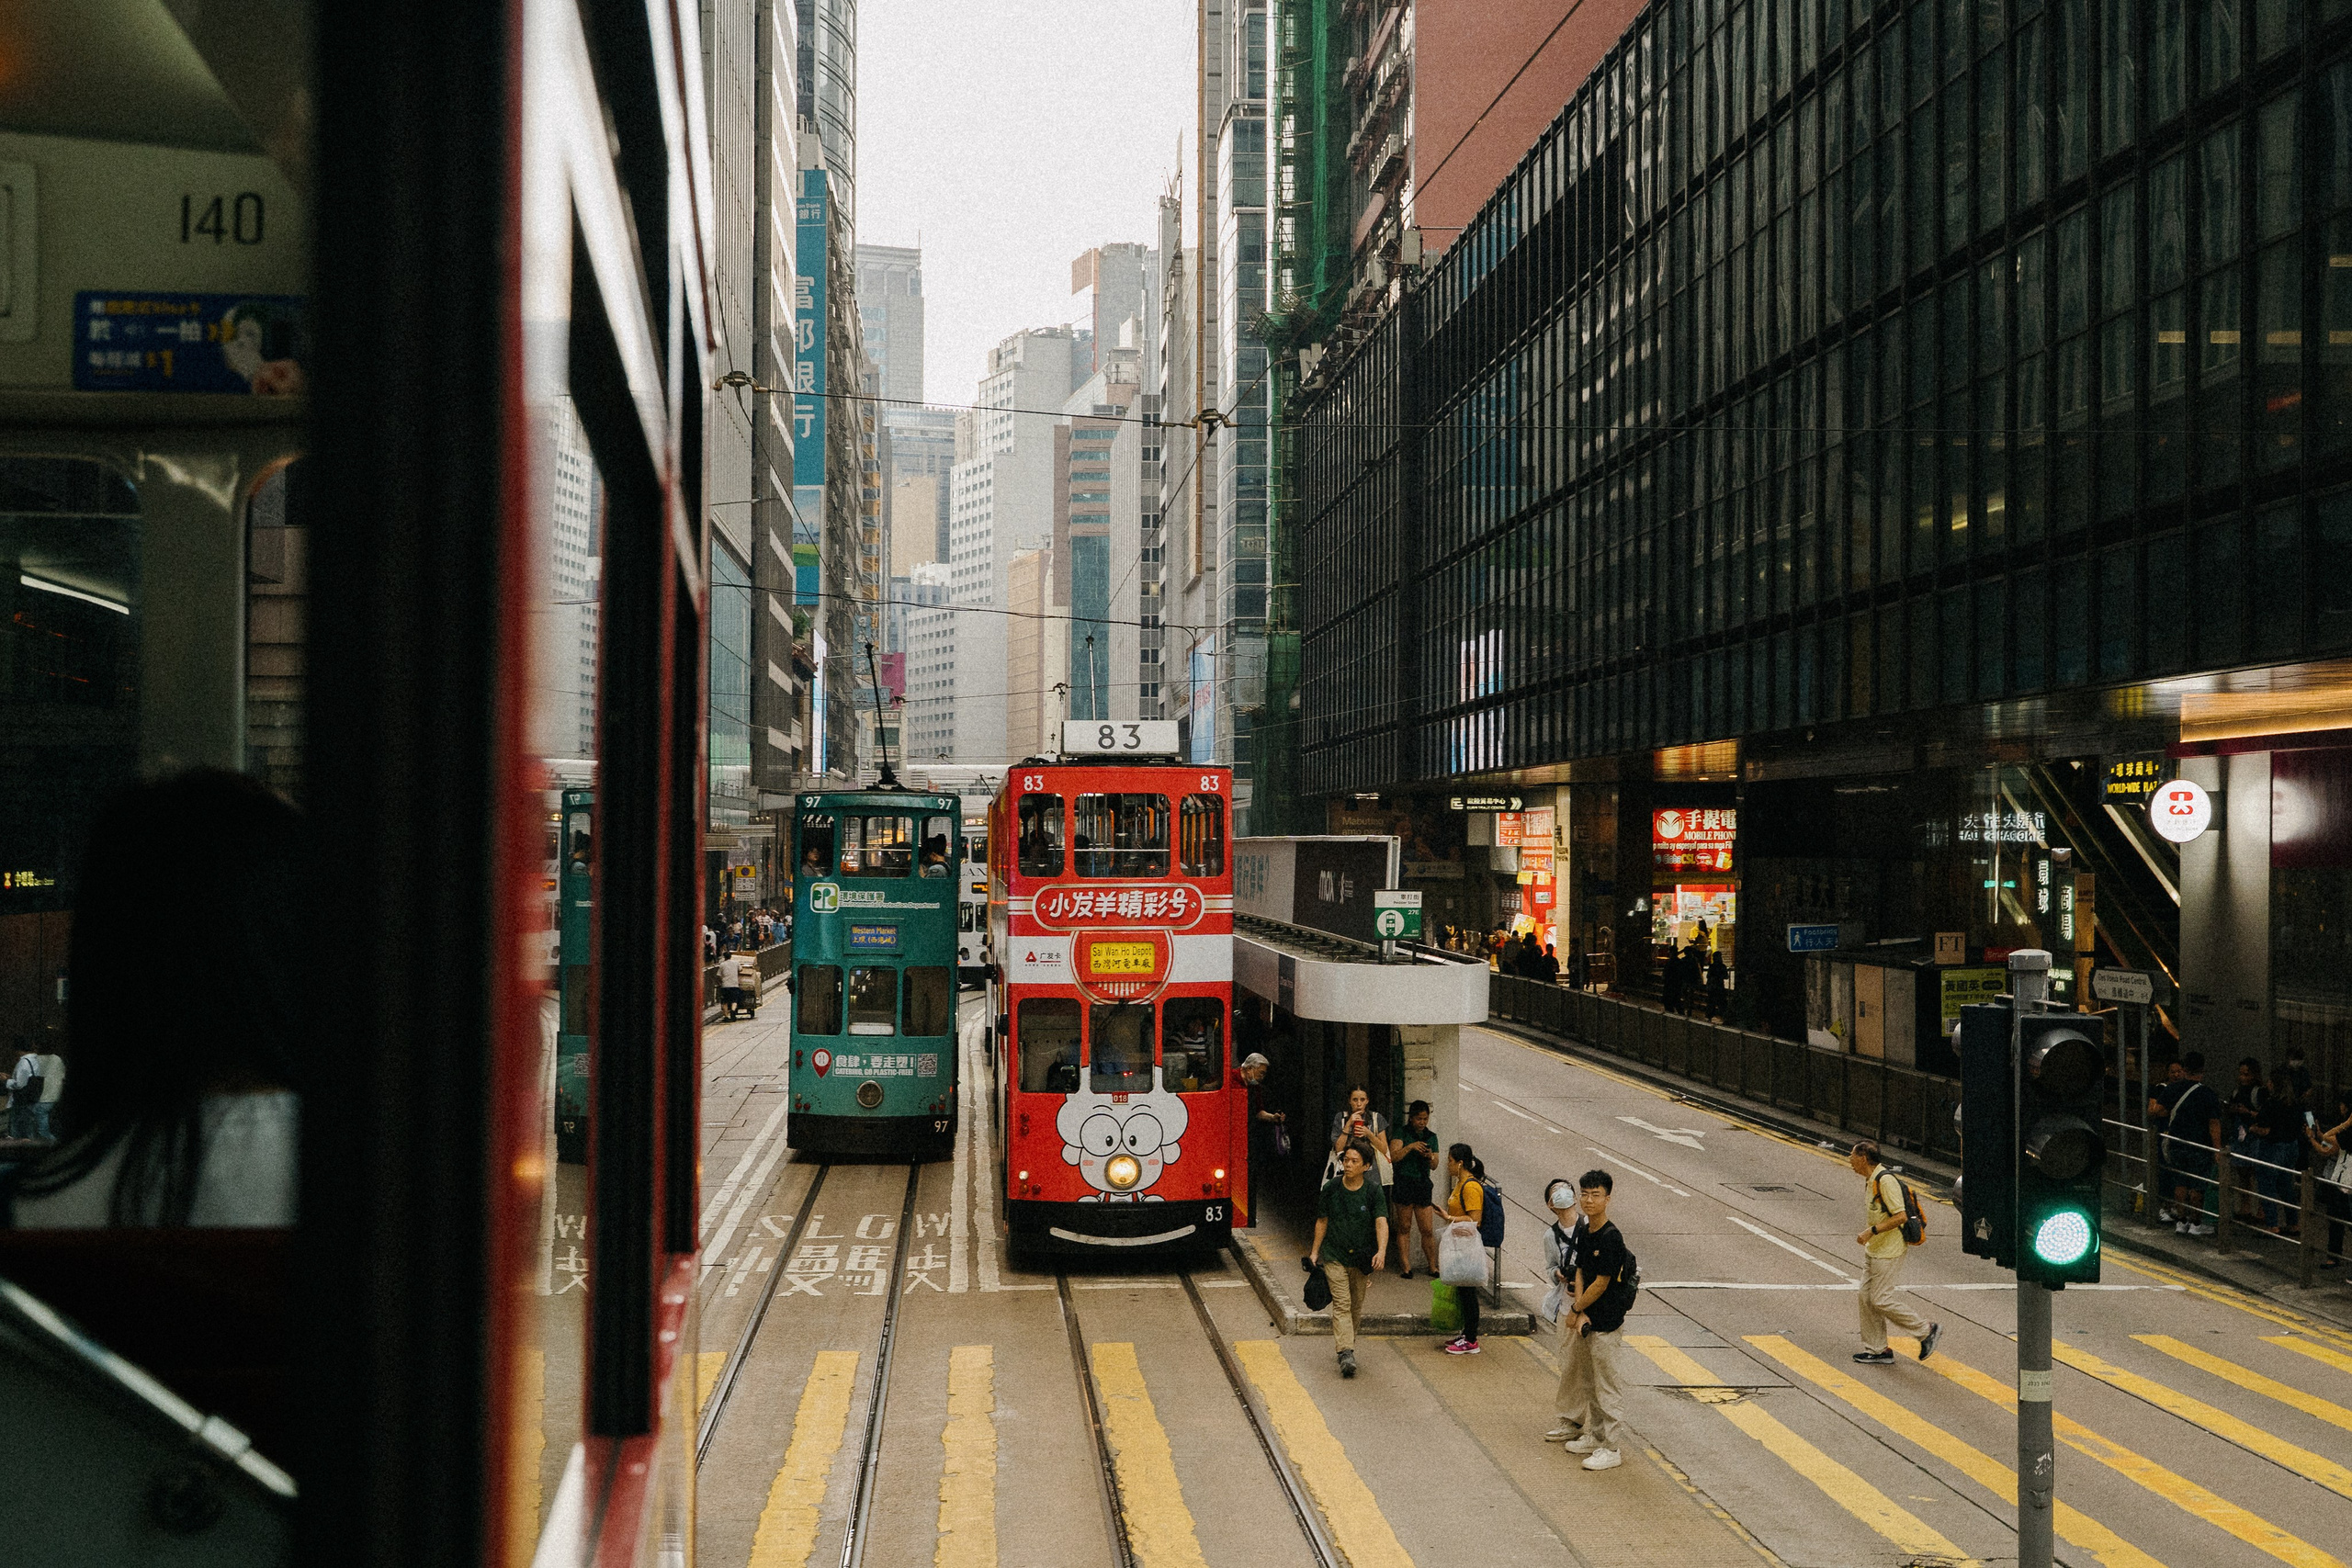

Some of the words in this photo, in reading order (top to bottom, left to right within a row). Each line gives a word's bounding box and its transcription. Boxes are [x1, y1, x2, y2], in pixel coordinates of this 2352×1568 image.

[181, 191, 265, 245] 140
[1097, 724, 1141, 750] 83
[1023, 775, 1044, 792] 83
[1200, 775, 1219, 792] 83
[2107, 782, 2140, 794] WORLD-WIDE
[805, 796, 821, 808] 97
[937, 798, 953, 810] 97
[1341, 816, 1384, 827] Mabuting
[1685, 808, 1736, 830] 手提電
[1684, 830, 1713, 840] MOBILE
[1048, 887, 1188, 919] 小发羊精彩号
[876, 927, 897, 935] Market
[1938, 936, 1963, 952] FT
[1092, 946, 1102, 956] Sai
[1105, 946, 1119, 956] Wan
[1121, 946, 1130, 956] Ho
[1132, 945, 1152, 958] Depot
[1092, 958, 1152, 969] 西灣河電車廠
[2098, 973, 2106, 981] Des
[2120, 976, 2130, 984] Road
[2131, 976, 2147, 986] Central
[1113, 1094, 1128, 1102] 018
[933, 1120, 949, 1133] 97
[1205, 1206, 1223, 1222] 83
[746, 1213, 952, 1240] SLOW
